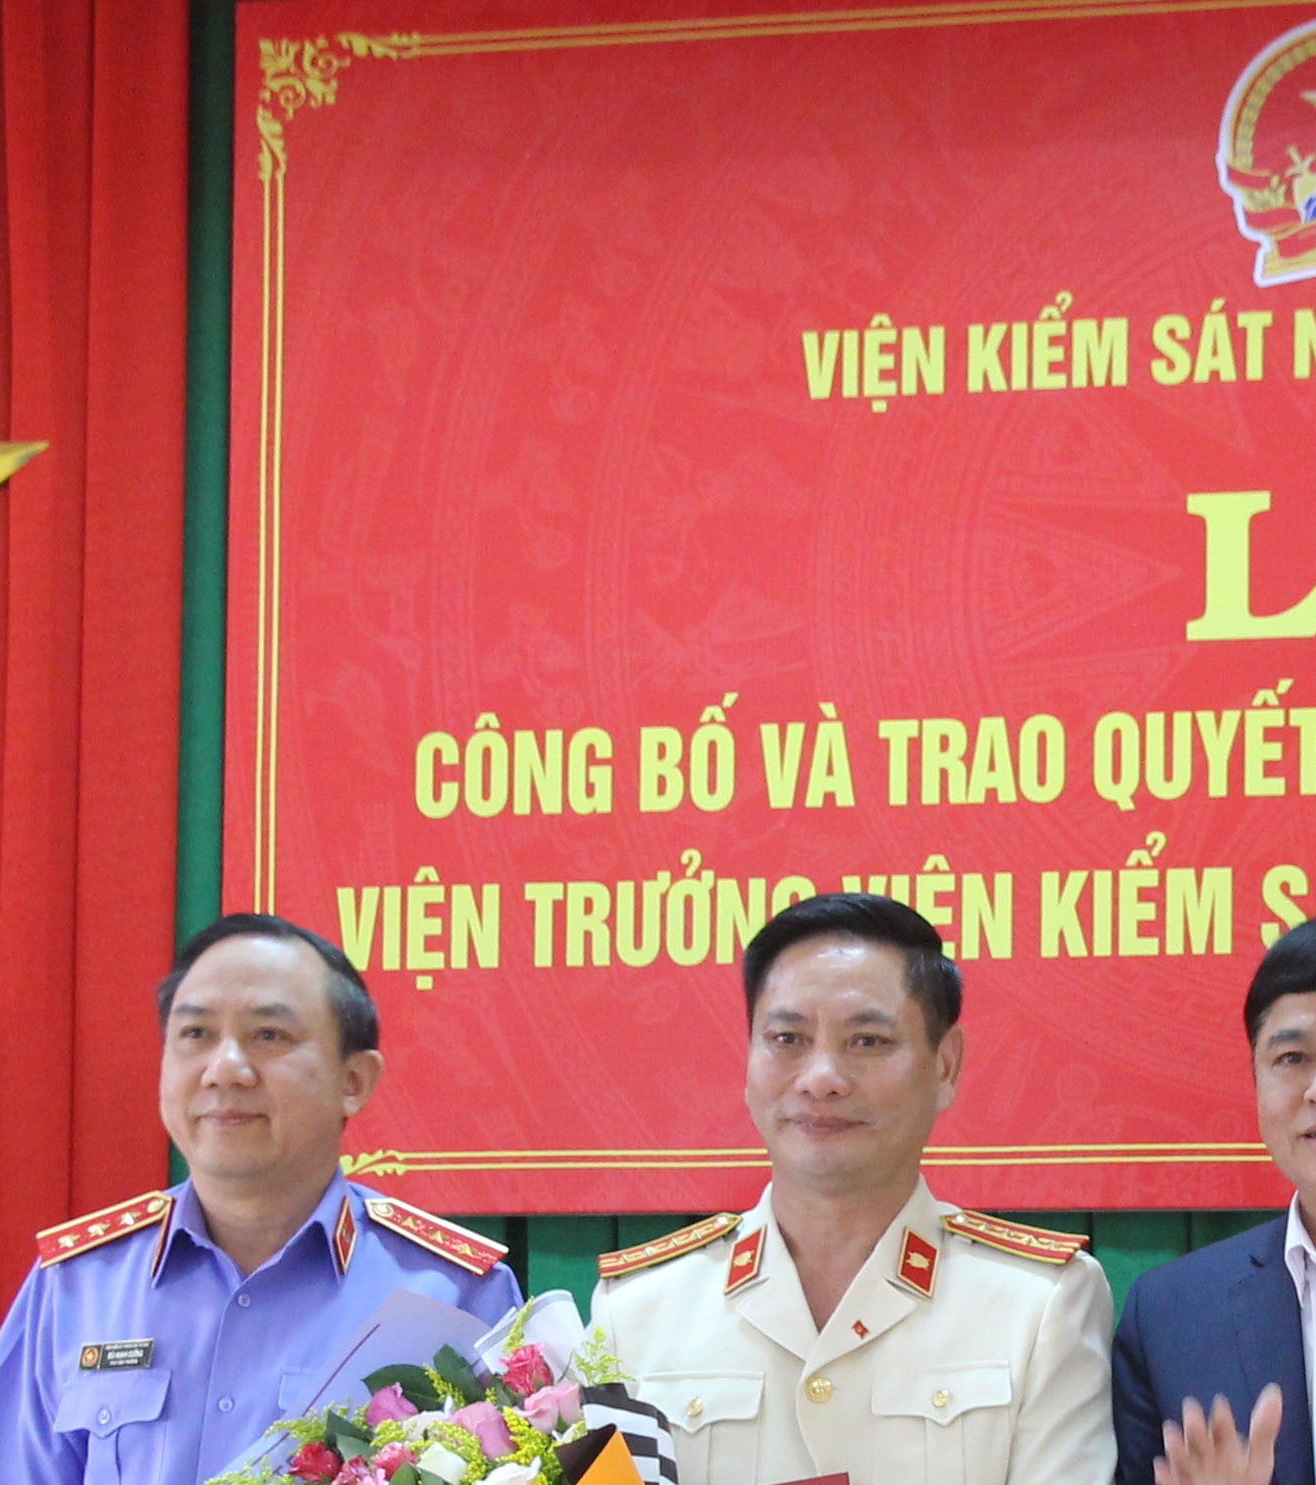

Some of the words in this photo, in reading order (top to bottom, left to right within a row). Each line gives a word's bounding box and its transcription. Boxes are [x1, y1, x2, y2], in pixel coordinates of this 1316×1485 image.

[802, 314, 945, 412] VIỆN
[967, 291, 1128, 392] KIỂM
[1151, 298, 1273, 385] SÁT
[415, 712, 613, 818] CÔNG
[639, 692, 738, 812] BỐ
[760, 702, 855, 808] VÀ
[878, 714, 1065, 806] TRAO
[337, 866, 500, 990] VIỆN
[1041, 831, 1232, 958] KIỂM
